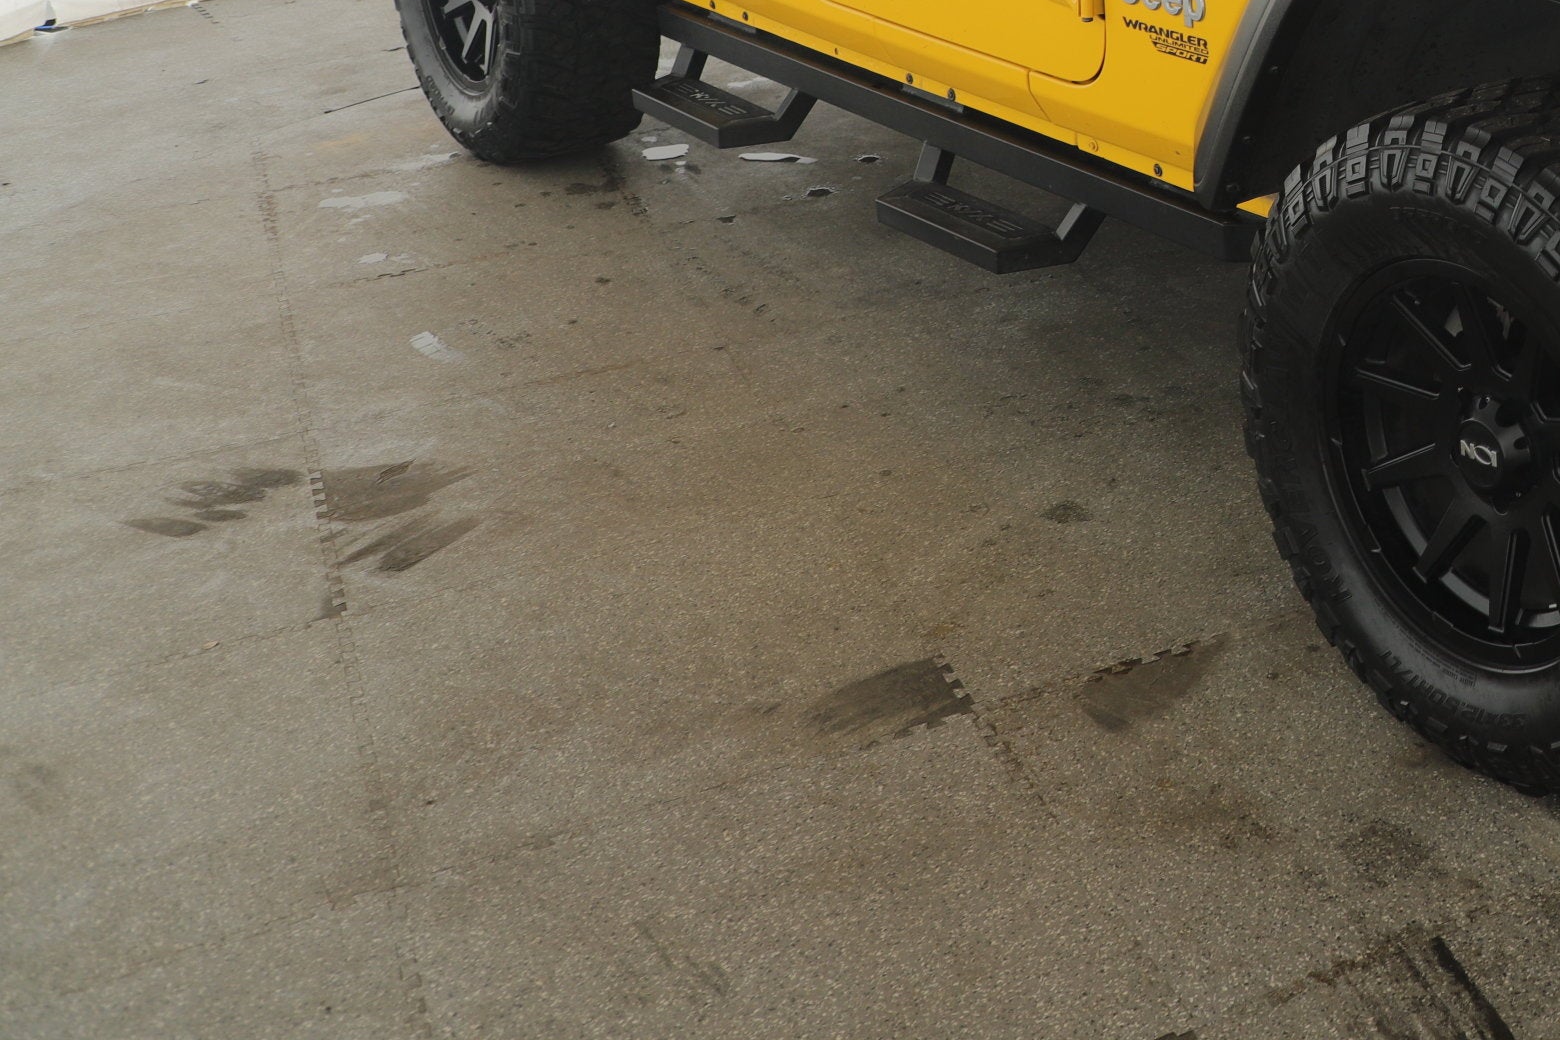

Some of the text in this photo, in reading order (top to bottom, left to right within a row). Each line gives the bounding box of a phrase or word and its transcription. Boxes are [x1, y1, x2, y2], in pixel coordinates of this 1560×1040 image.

[1123, 16, 1209, 51] WRANGLER
[1149, 34, 1209, 56] UNLIMITED
[1155, 42, 1209, 64] SPORT
